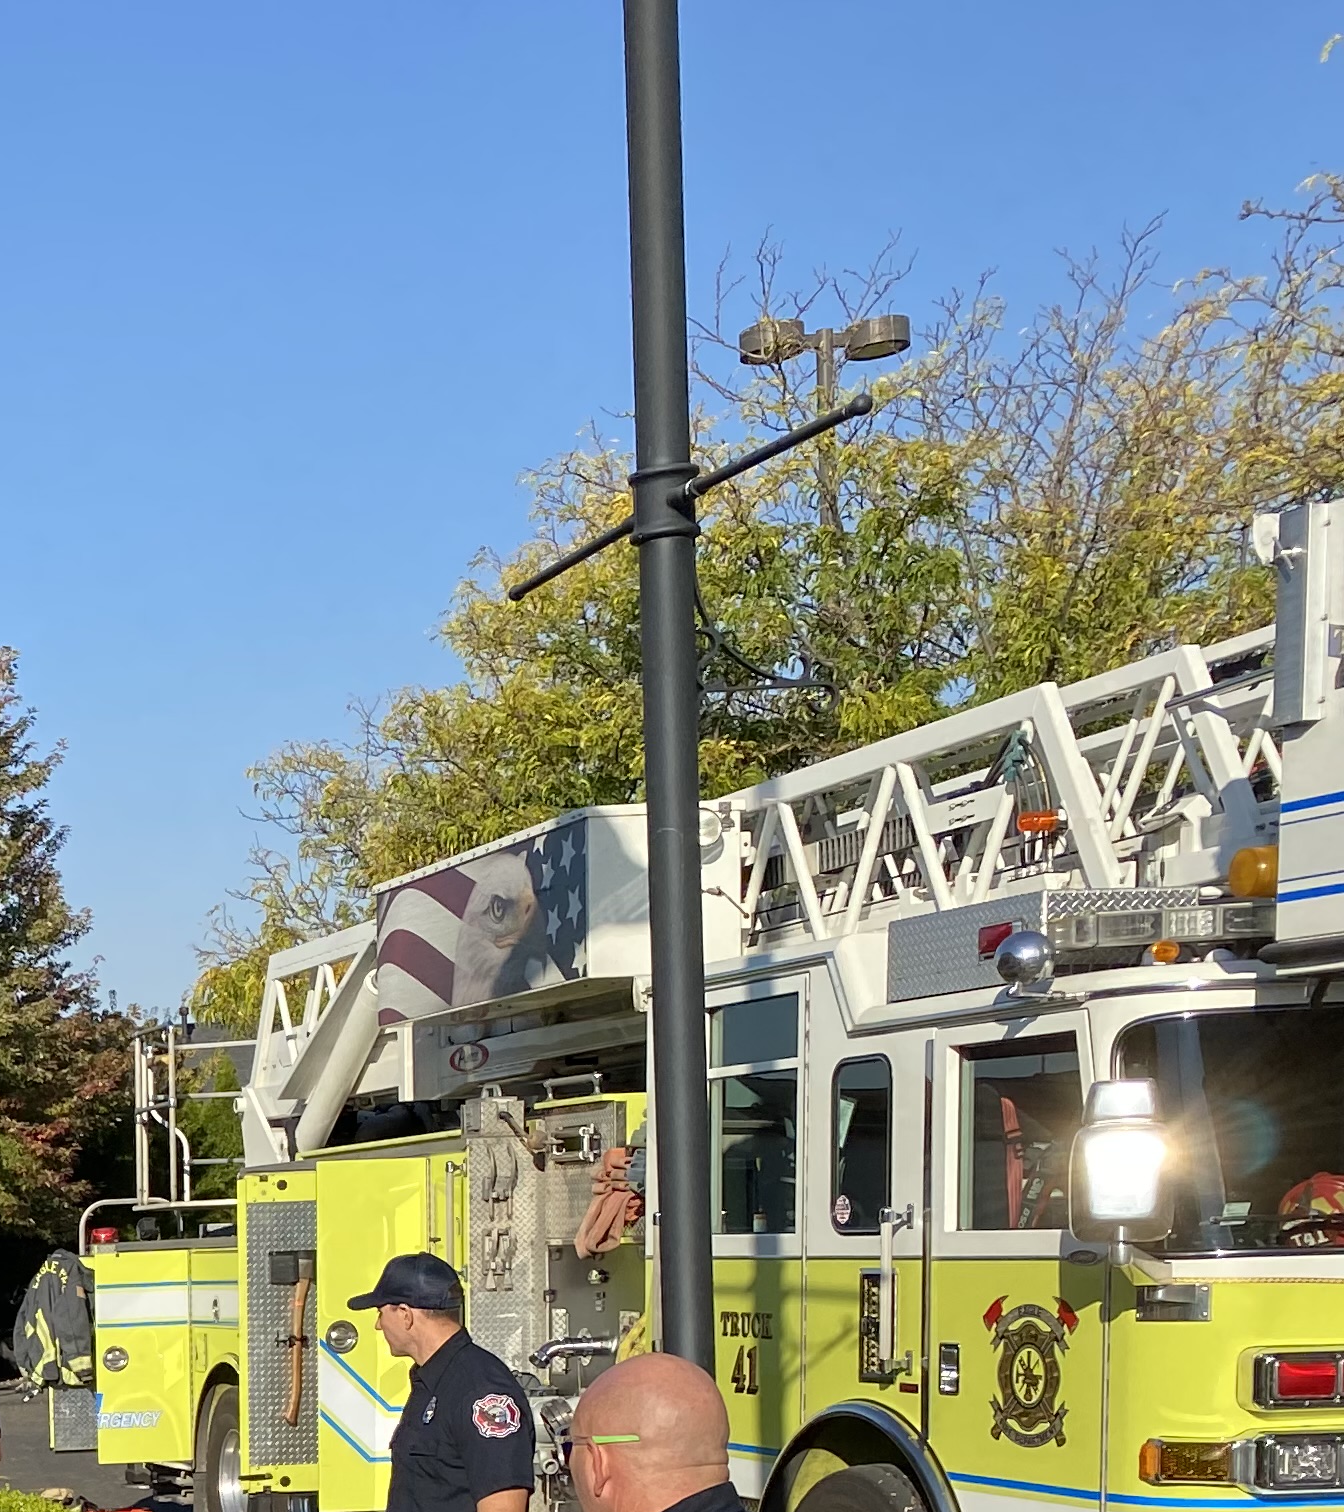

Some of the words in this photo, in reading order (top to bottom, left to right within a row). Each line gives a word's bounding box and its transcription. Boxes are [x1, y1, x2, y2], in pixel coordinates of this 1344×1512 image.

[1026, 1177, 1045, 1200] 3M
[720, 1312, 773, 1339] TRUCK
[730, 1345, 759, 1395] 41
